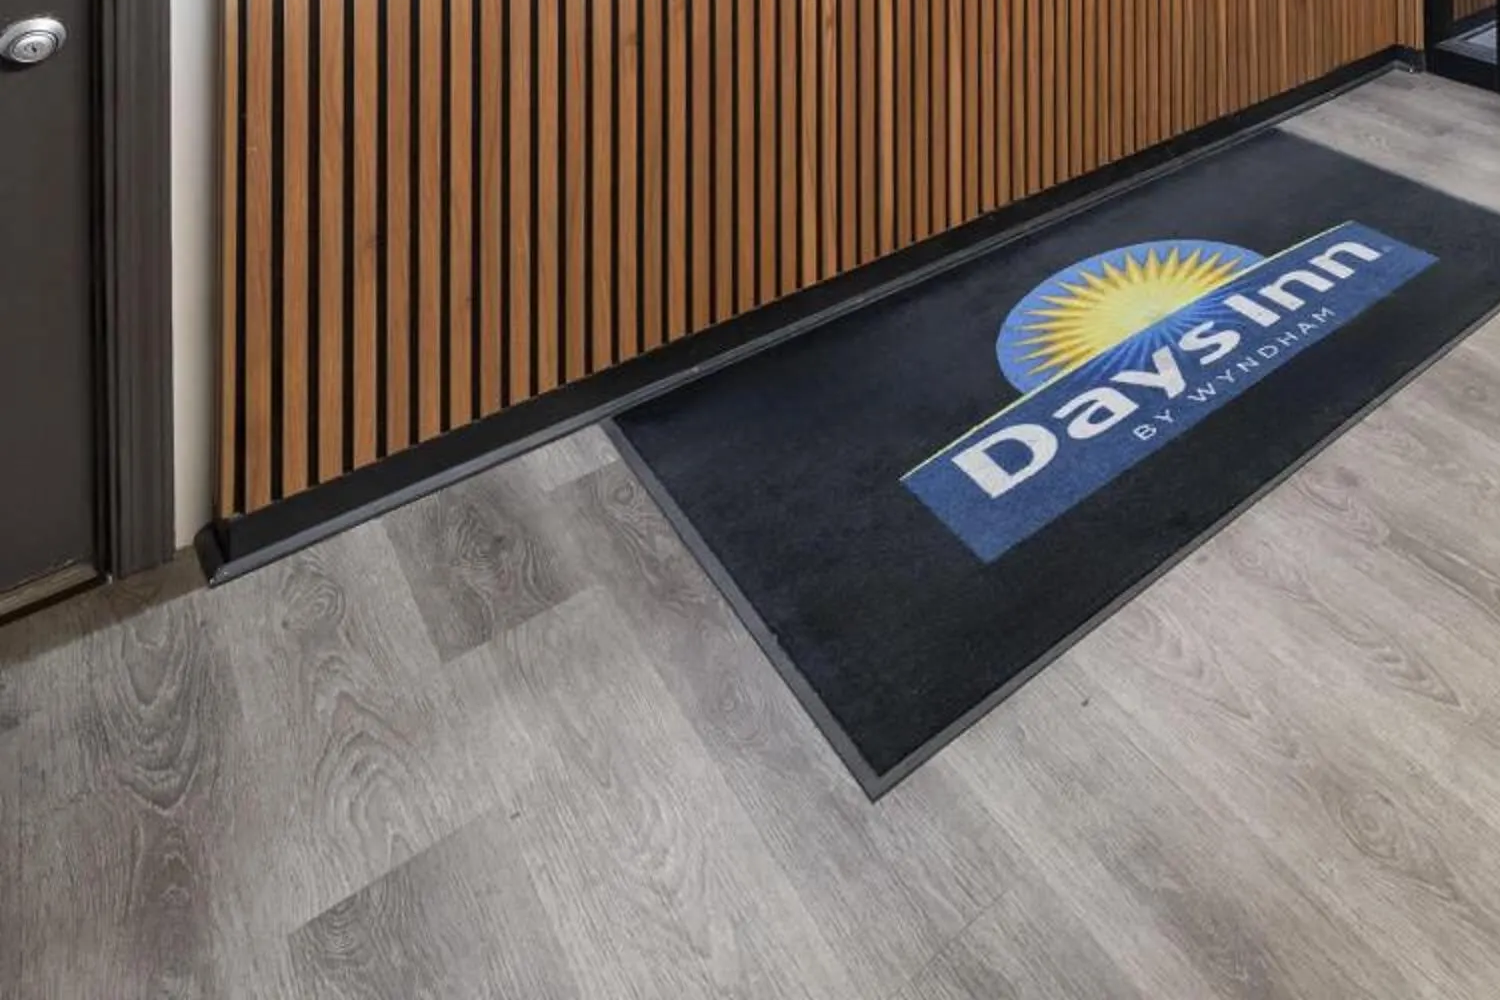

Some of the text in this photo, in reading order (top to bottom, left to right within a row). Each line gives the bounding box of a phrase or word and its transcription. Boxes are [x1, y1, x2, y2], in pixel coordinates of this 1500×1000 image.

[951, 240, 1383, 499] Days Inn
[1132, 305, 1337, 442] BY WYNDHAM
